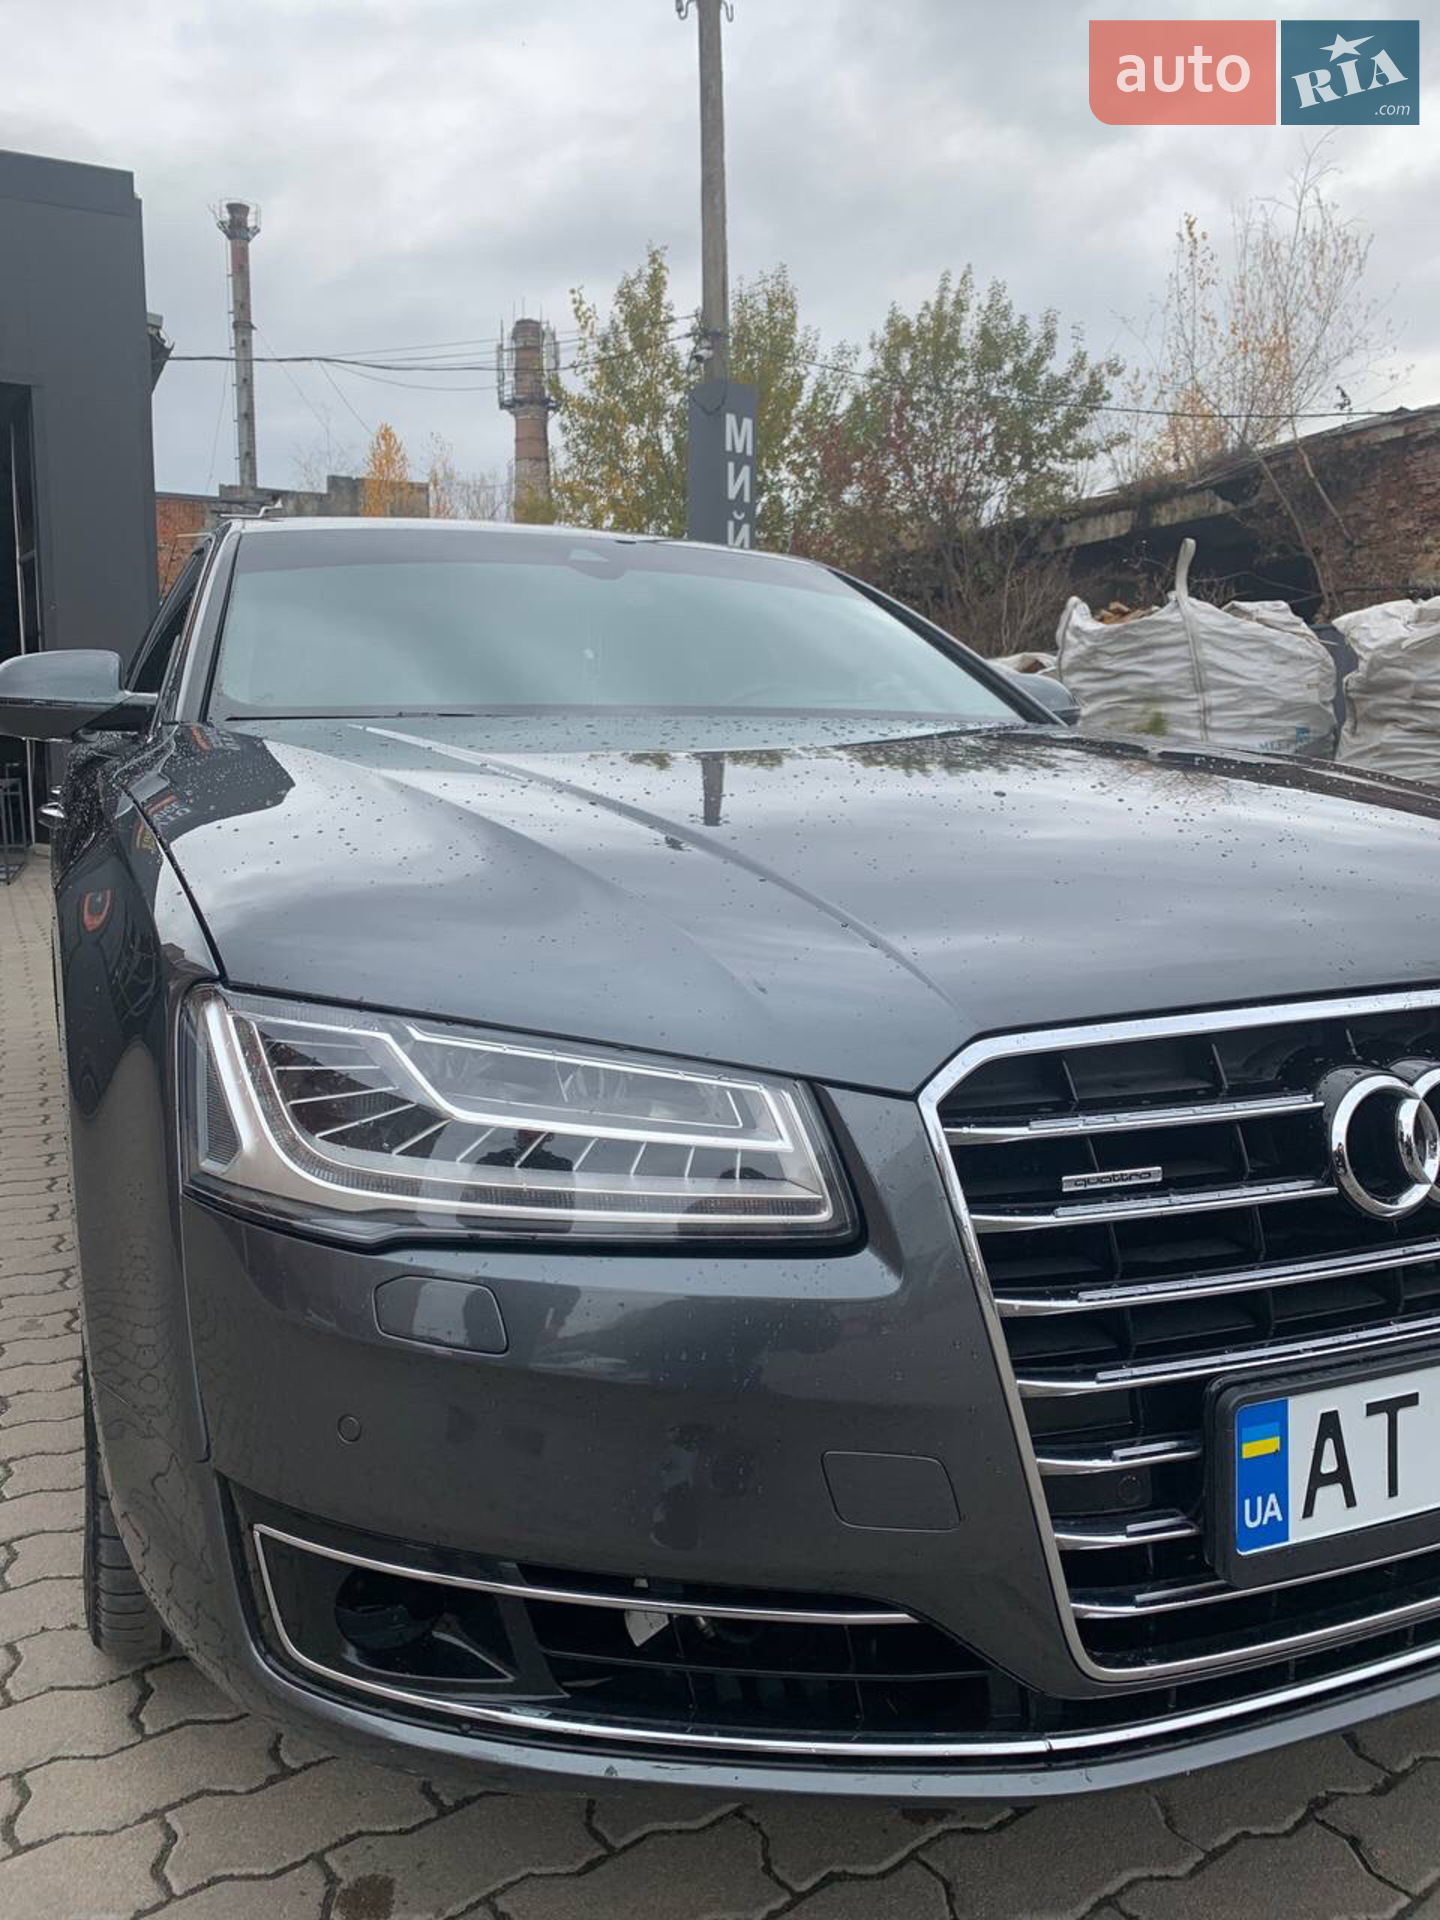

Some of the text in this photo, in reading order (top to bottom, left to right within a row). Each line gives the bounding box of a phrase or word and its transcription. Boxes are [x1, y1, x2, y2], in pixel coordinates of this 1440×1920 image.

[1074, 1171, 1151, 1188] quattro
[1302, 1392, 1419, 1519] AT
[1244, 1493, 1283, 1528] UA
